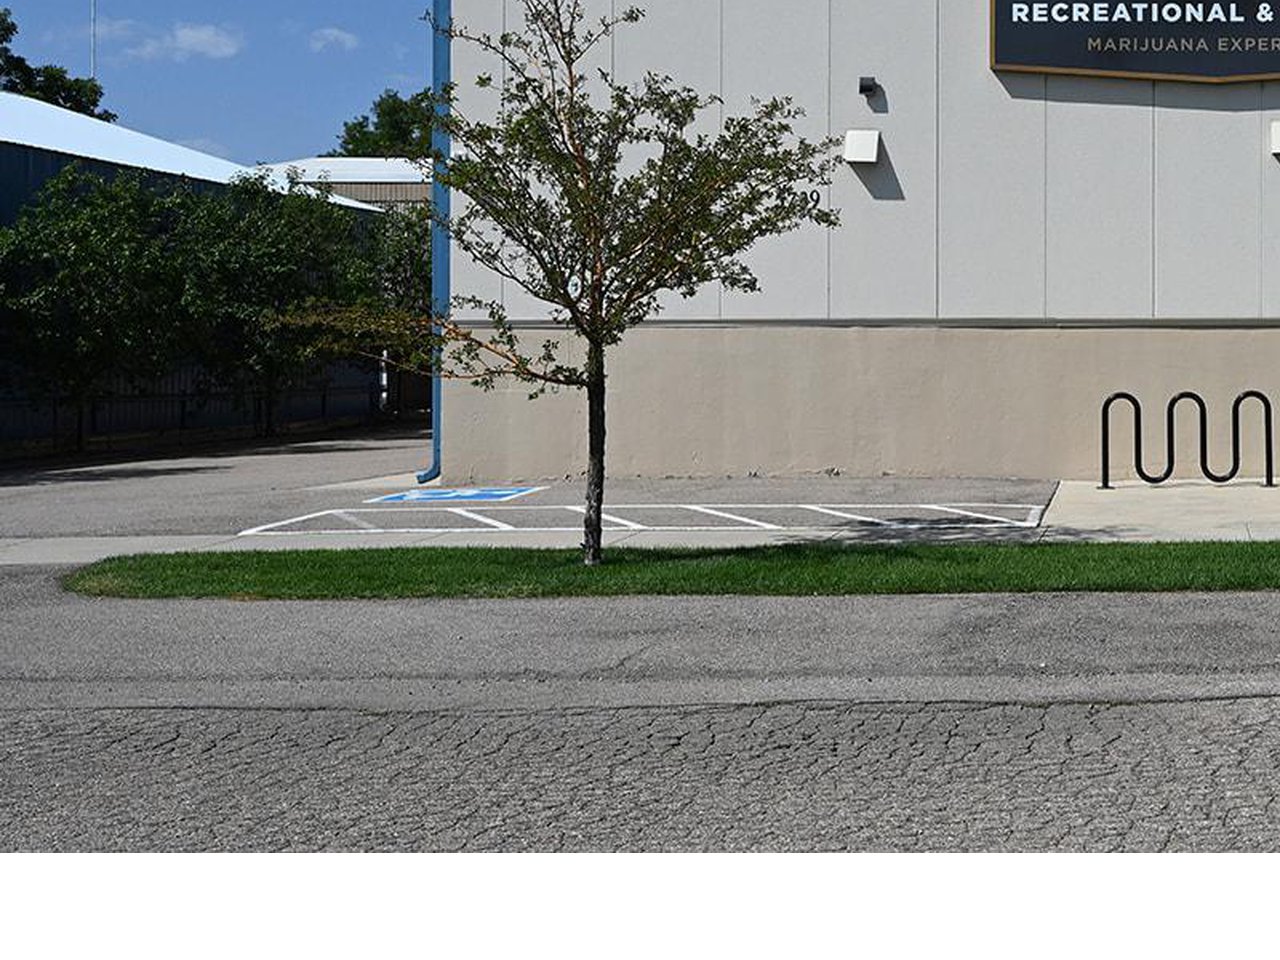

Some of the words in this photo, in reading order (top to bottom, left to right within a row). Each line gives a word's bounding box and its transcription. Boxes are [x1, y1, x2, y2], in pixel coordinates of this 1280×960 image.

[1011, 2, 1245, 23] RECREATIONAL
[1256, 2, 1275, 23] &
[1087, 36, 1210, 52] MARIJUANA
